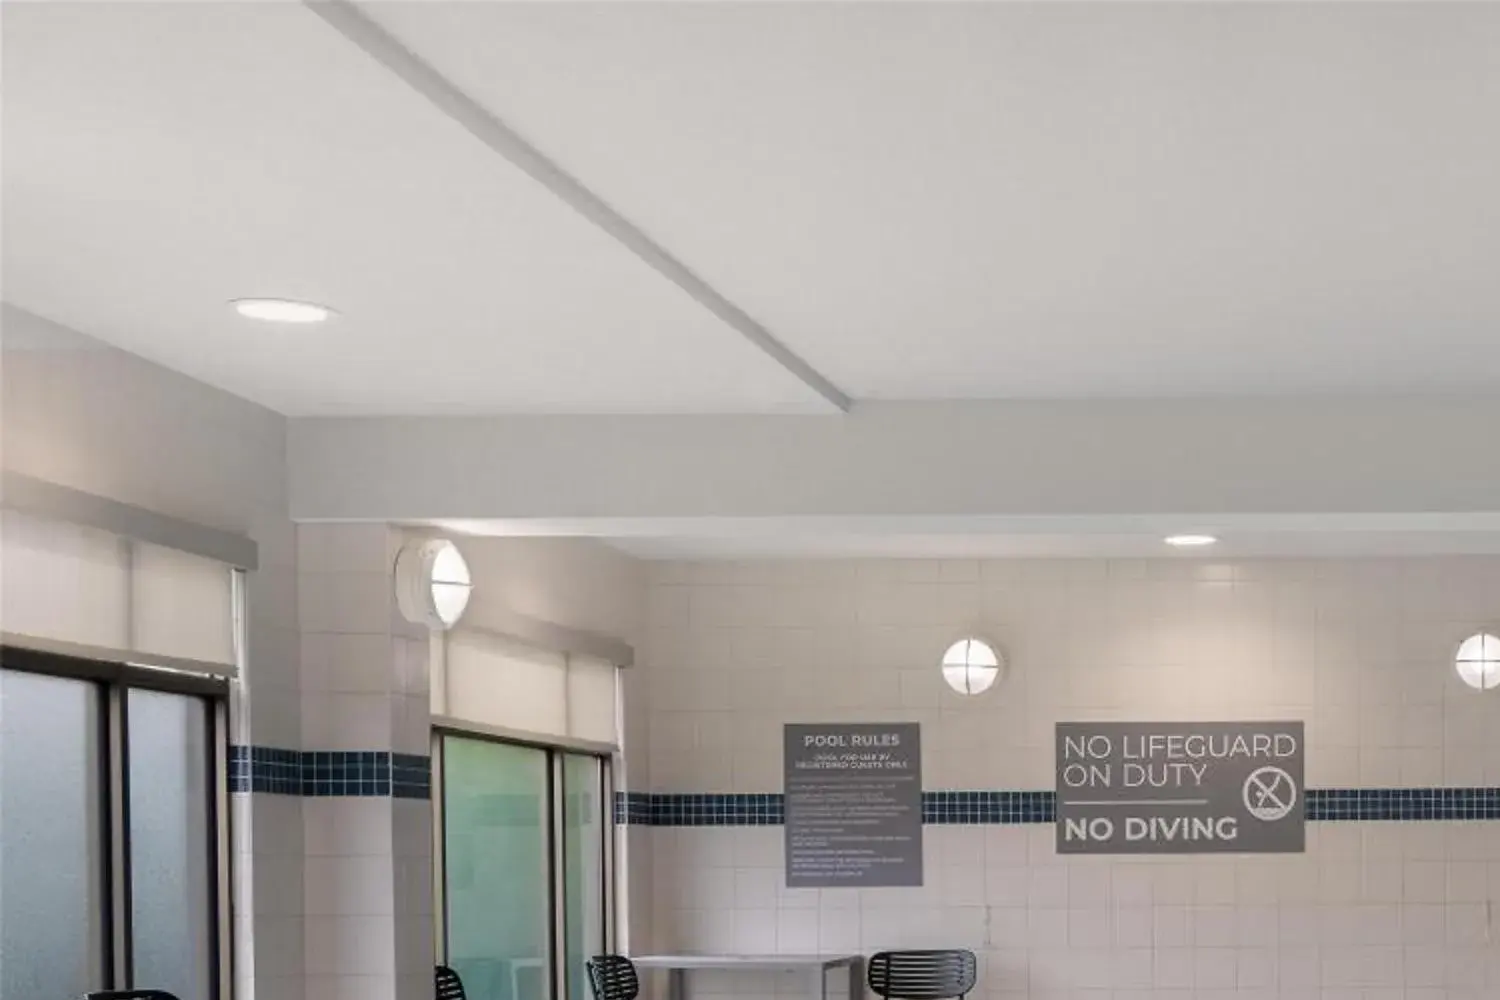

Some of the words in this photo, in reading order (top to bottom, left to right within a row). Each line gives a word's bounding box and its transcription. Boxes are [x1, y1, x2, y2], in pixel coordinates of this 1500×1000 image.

[804, 735, 847, 748] POOL
[851, 734, 900, 747] RULES
[1064, 735, 1112, 759] NO
[1122, 733, 1297, 759] LIFEGUARD
[1063, 763, 1111, 787] ON
[1122, 762, 1208, 787] DUTY
[1064, 818, 1114, 841] NO
[1125, 816, 1238, 841] DIVING
